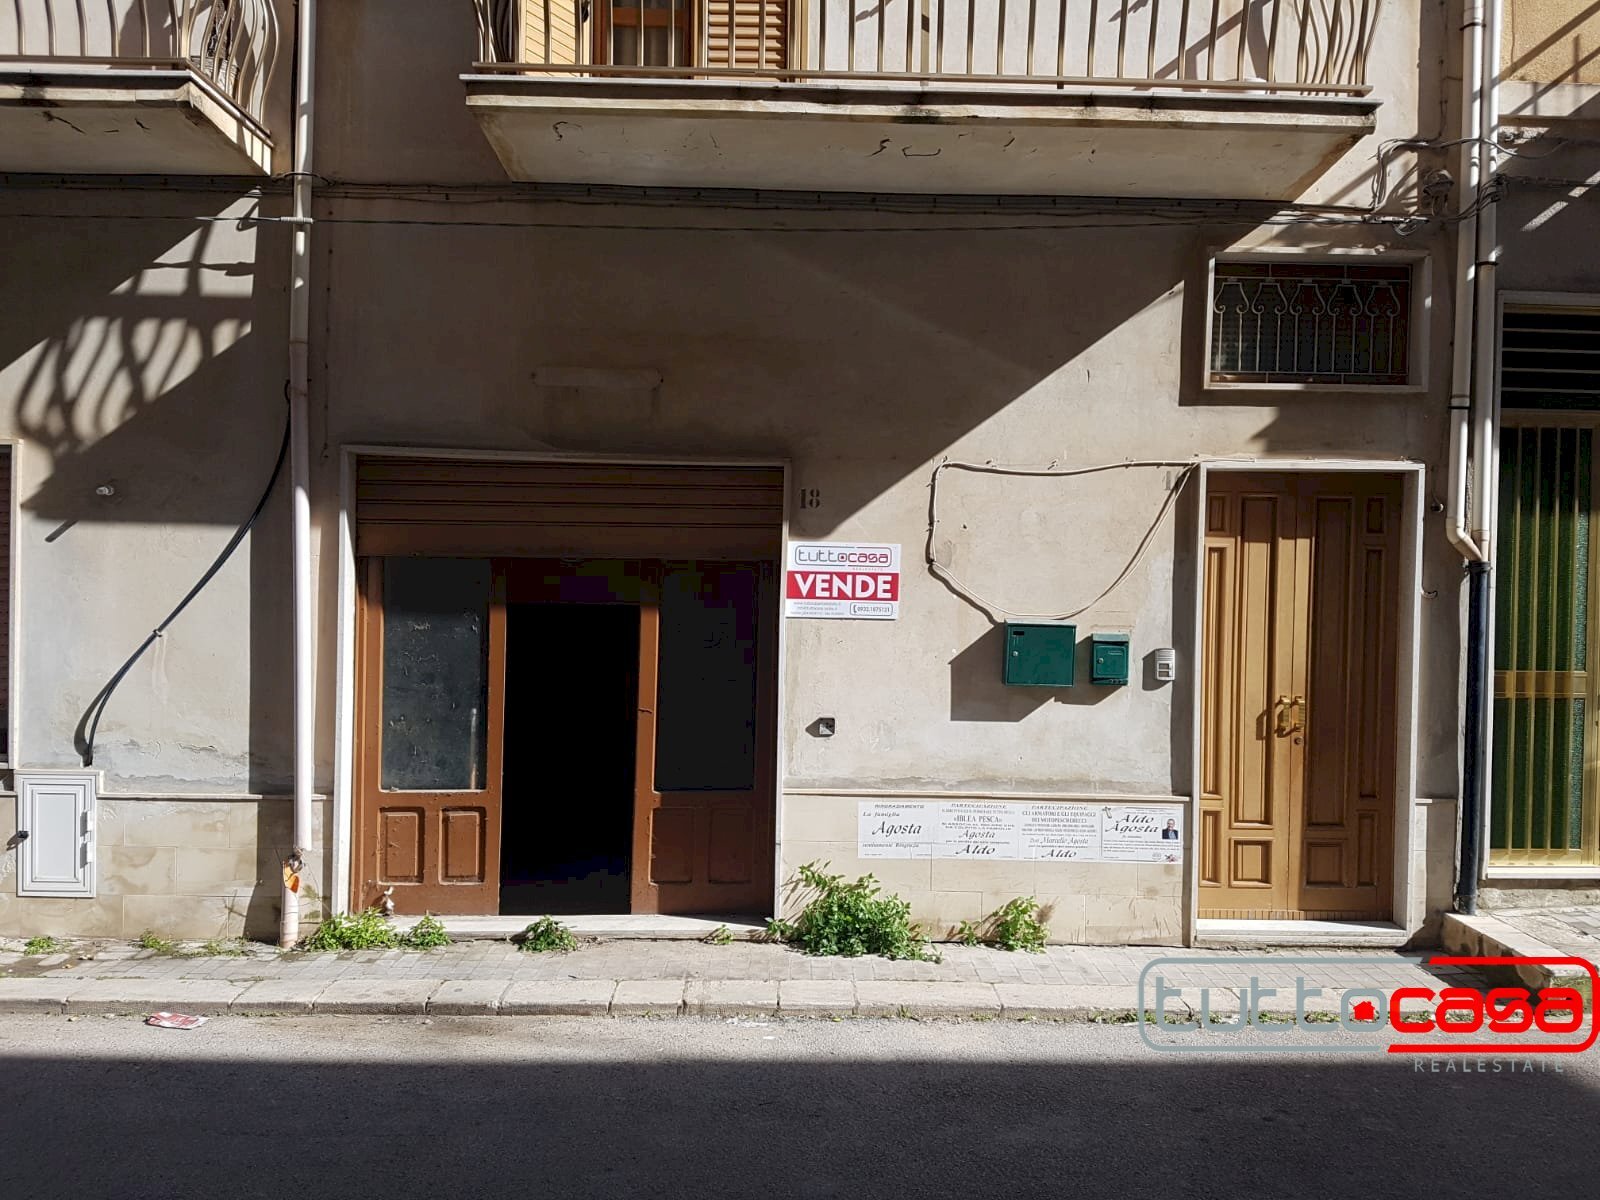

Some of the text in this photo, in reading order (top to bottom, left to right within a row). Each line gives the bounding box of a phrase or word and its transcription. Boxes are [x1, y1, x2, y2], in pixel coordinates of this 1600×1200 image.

[799, 488, 820, 509] 18
[798, 549, 889, 564] tuttocasa
[794, 573, 893, 599] VENDE
[1115, 814, 1155, 824] Aldo
[871, 820, 923, 838] Agosta
[958, 826, 996, 840] Agosta
[1104, 823, 1160, 834] Agosta
[955, 844, 996, 855] Aldo
[1041, 848, 1077, 858] Aldo
